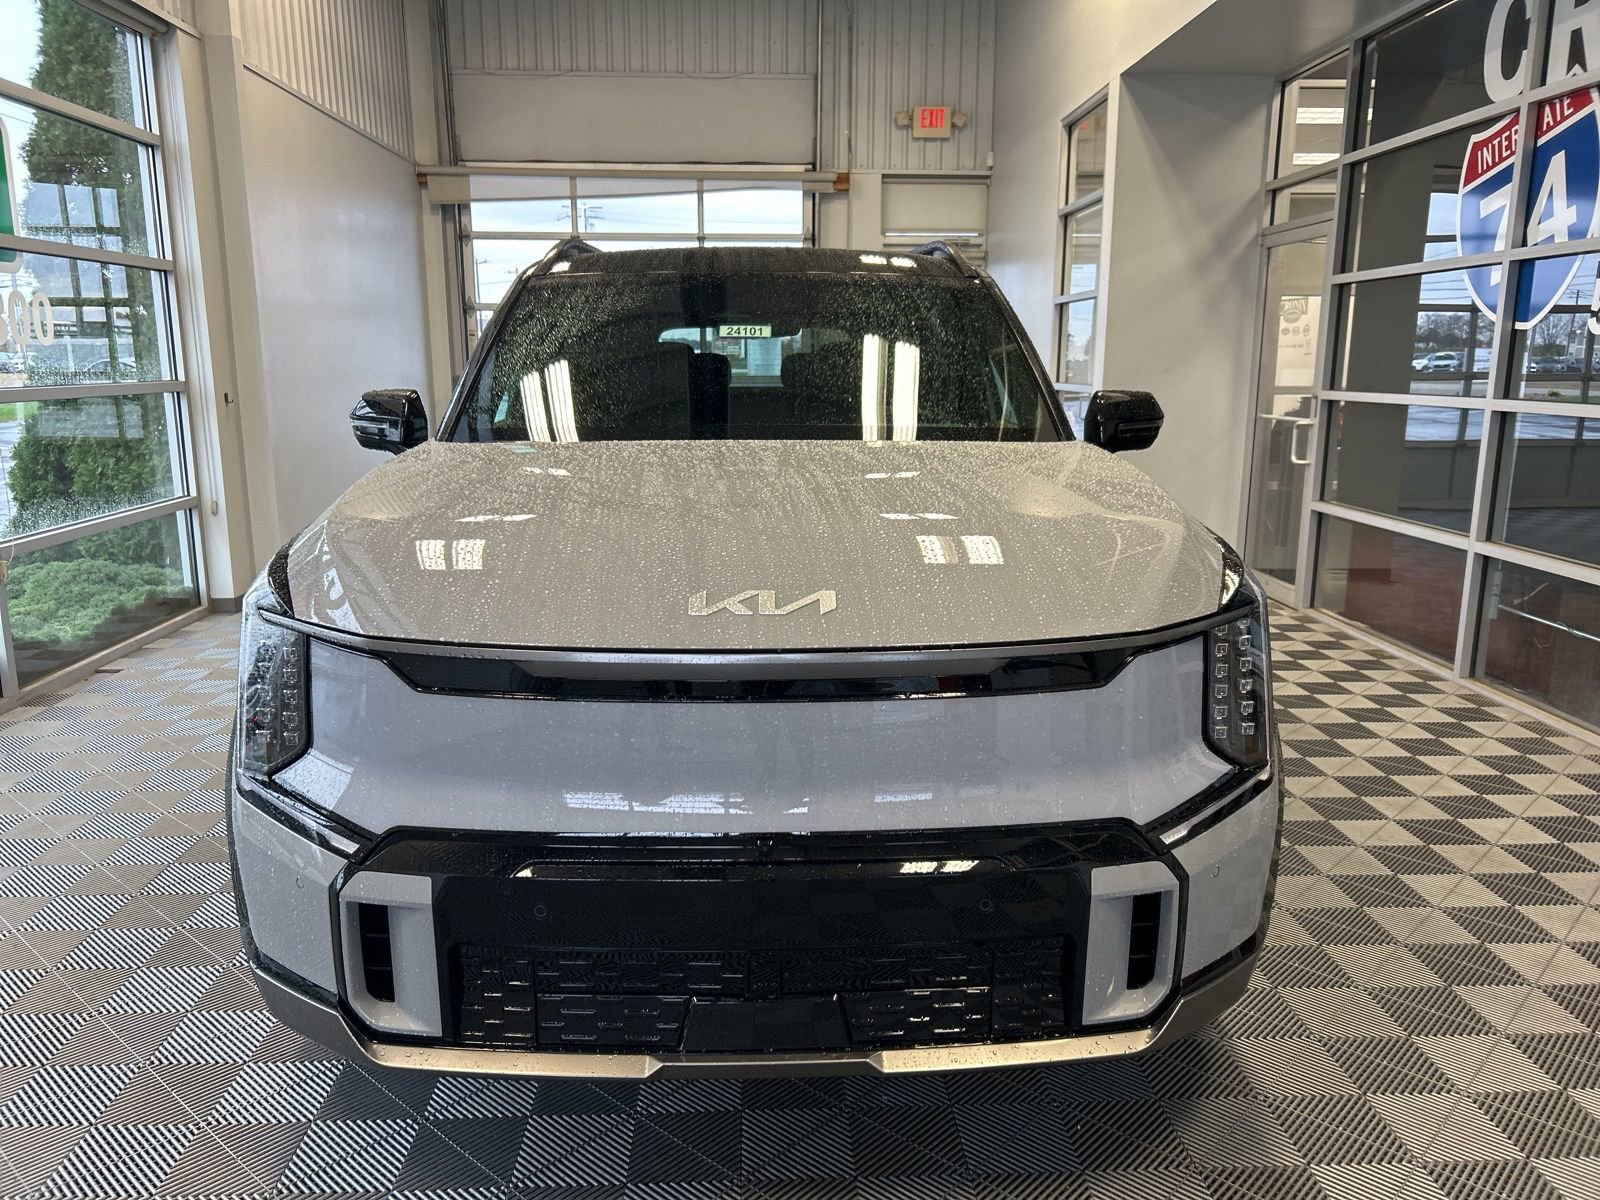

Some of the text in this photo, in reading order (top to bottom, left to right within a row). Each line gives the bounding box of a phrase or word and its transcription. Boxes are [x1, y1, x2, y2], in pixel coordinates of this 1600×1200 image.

[920, 108, 945, 128] EXIT
[1477, 96, 1574, 174] INTERATE
[1480, 150, 1577, 287] 74
[726, 326, 763, 336] 24101
[688, 590, 837, 615] KIA
